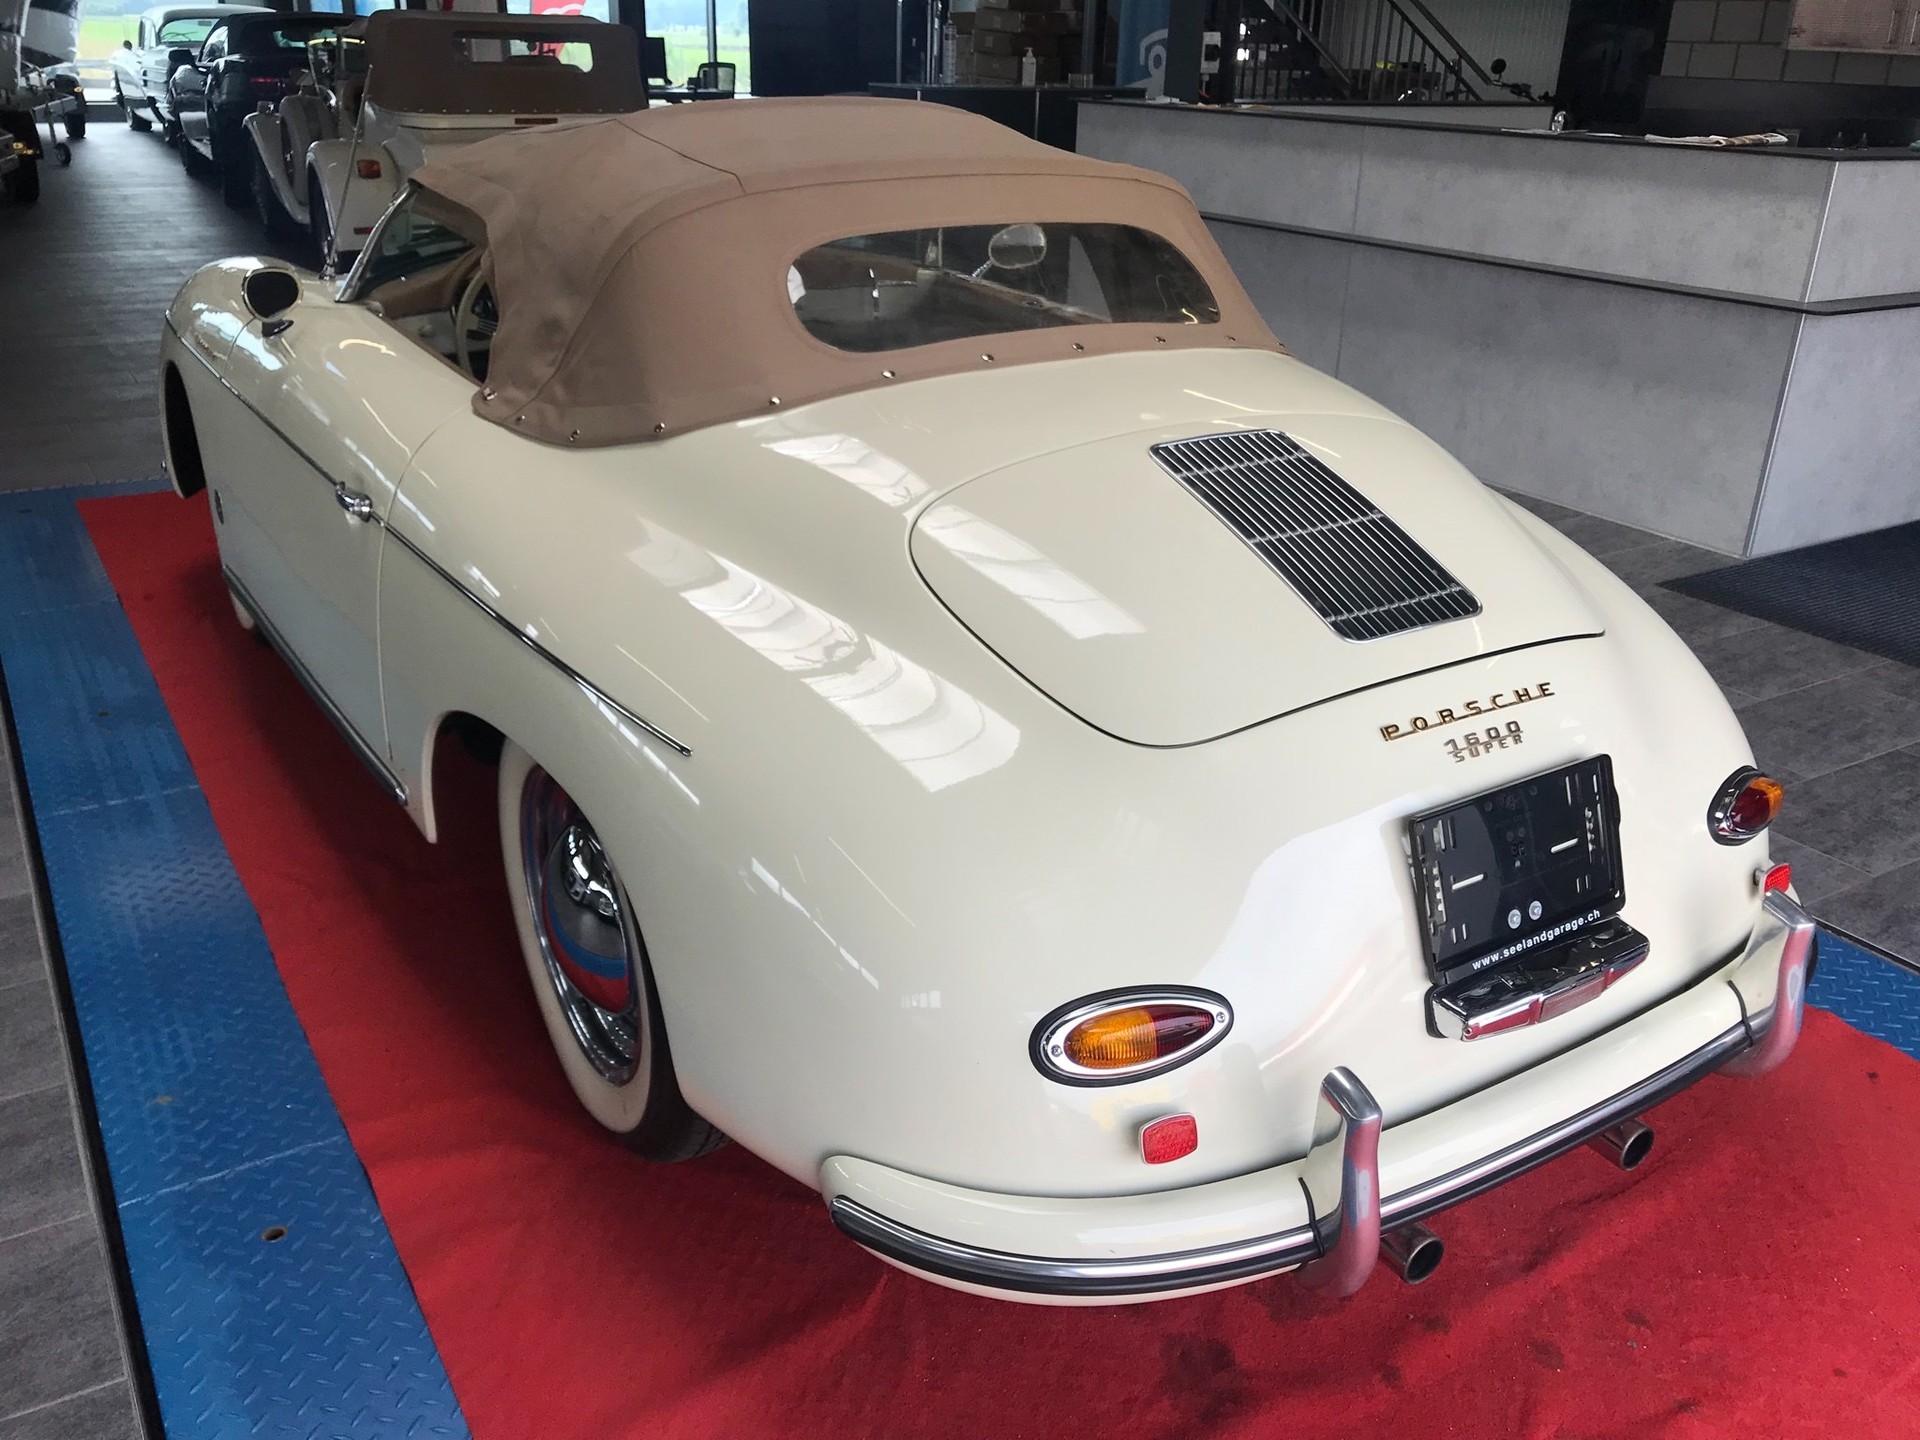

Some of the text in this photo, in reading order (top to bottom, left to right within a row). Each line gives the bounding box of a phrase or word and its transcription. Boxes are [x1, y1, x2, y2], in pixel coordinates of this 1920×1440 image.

[1380, 682, 1555, 742] PORSCHE
[1443, 720, 1523, 753] 1600
[1452, 733, 1523, 763] SUPER
[1472, 909, 1601, 970] www.seelandgarage.ch
